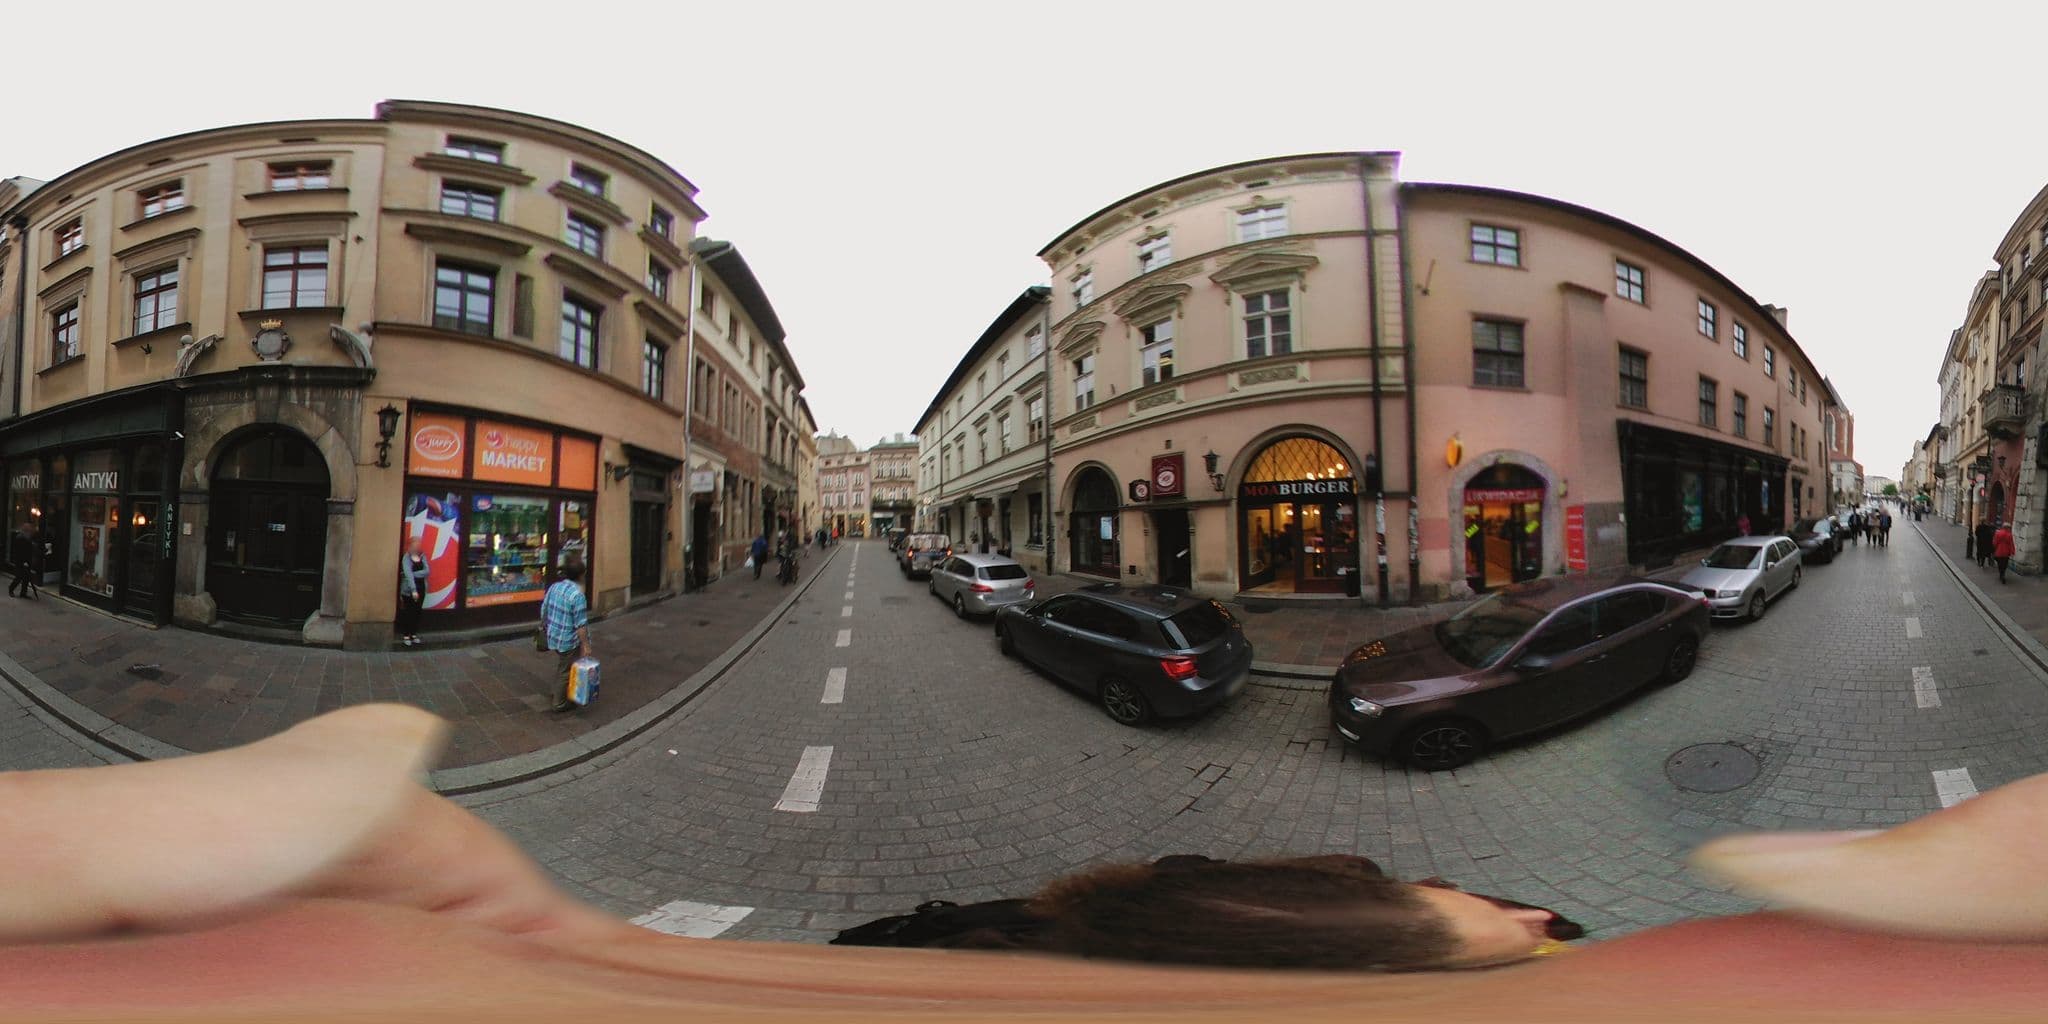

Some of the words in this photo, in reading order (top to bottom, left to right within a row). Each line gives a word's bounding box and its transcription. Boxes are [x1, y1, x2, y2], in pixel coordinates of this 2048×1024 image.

[482, 450, 546, 472] MARKET
[11, 474, 39, 489] ANTYKI
[74, 472, 118, 489] ANTYKI
[1466, 489, 1539, 501] LIKWIDACJA
[164, 503, 173, 558] ANTYKI
